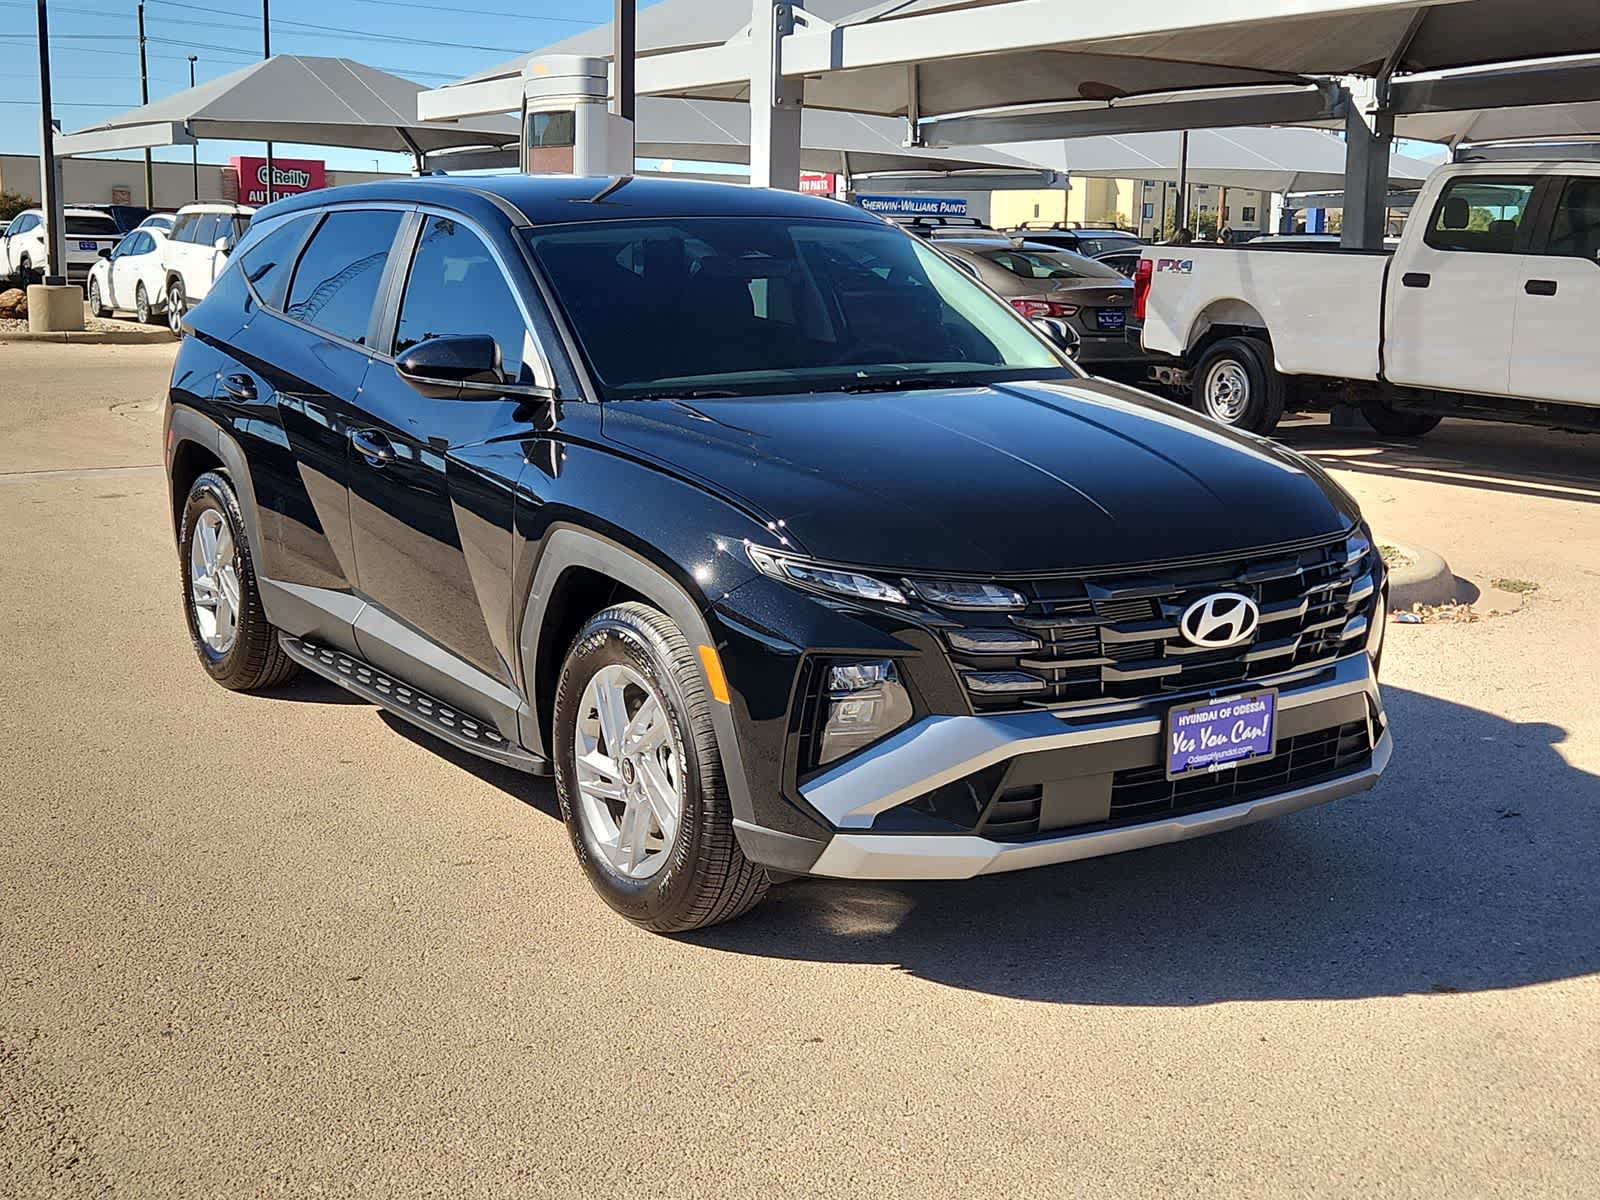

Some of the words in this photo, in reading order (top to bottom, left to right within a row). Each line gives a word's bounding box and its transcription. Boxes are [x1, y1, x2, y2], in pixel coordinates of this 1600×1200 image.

[861, 198, 938, 213] SHERWIN-WILLIAMS
[940, 201, 967, 214] PAINTS
[1157, 259, 1193, 272] FX4
[1179, 711, 1217, 726] HYUNDAI
[1219, 709, 1231, 720] OF
[1233, 701, 1265, 716] ODESSA
[1172, 731, 1196, 755] Yes
[1201, 726, 1228, 749] You
[1231, 714, 1269, 743] Can!
